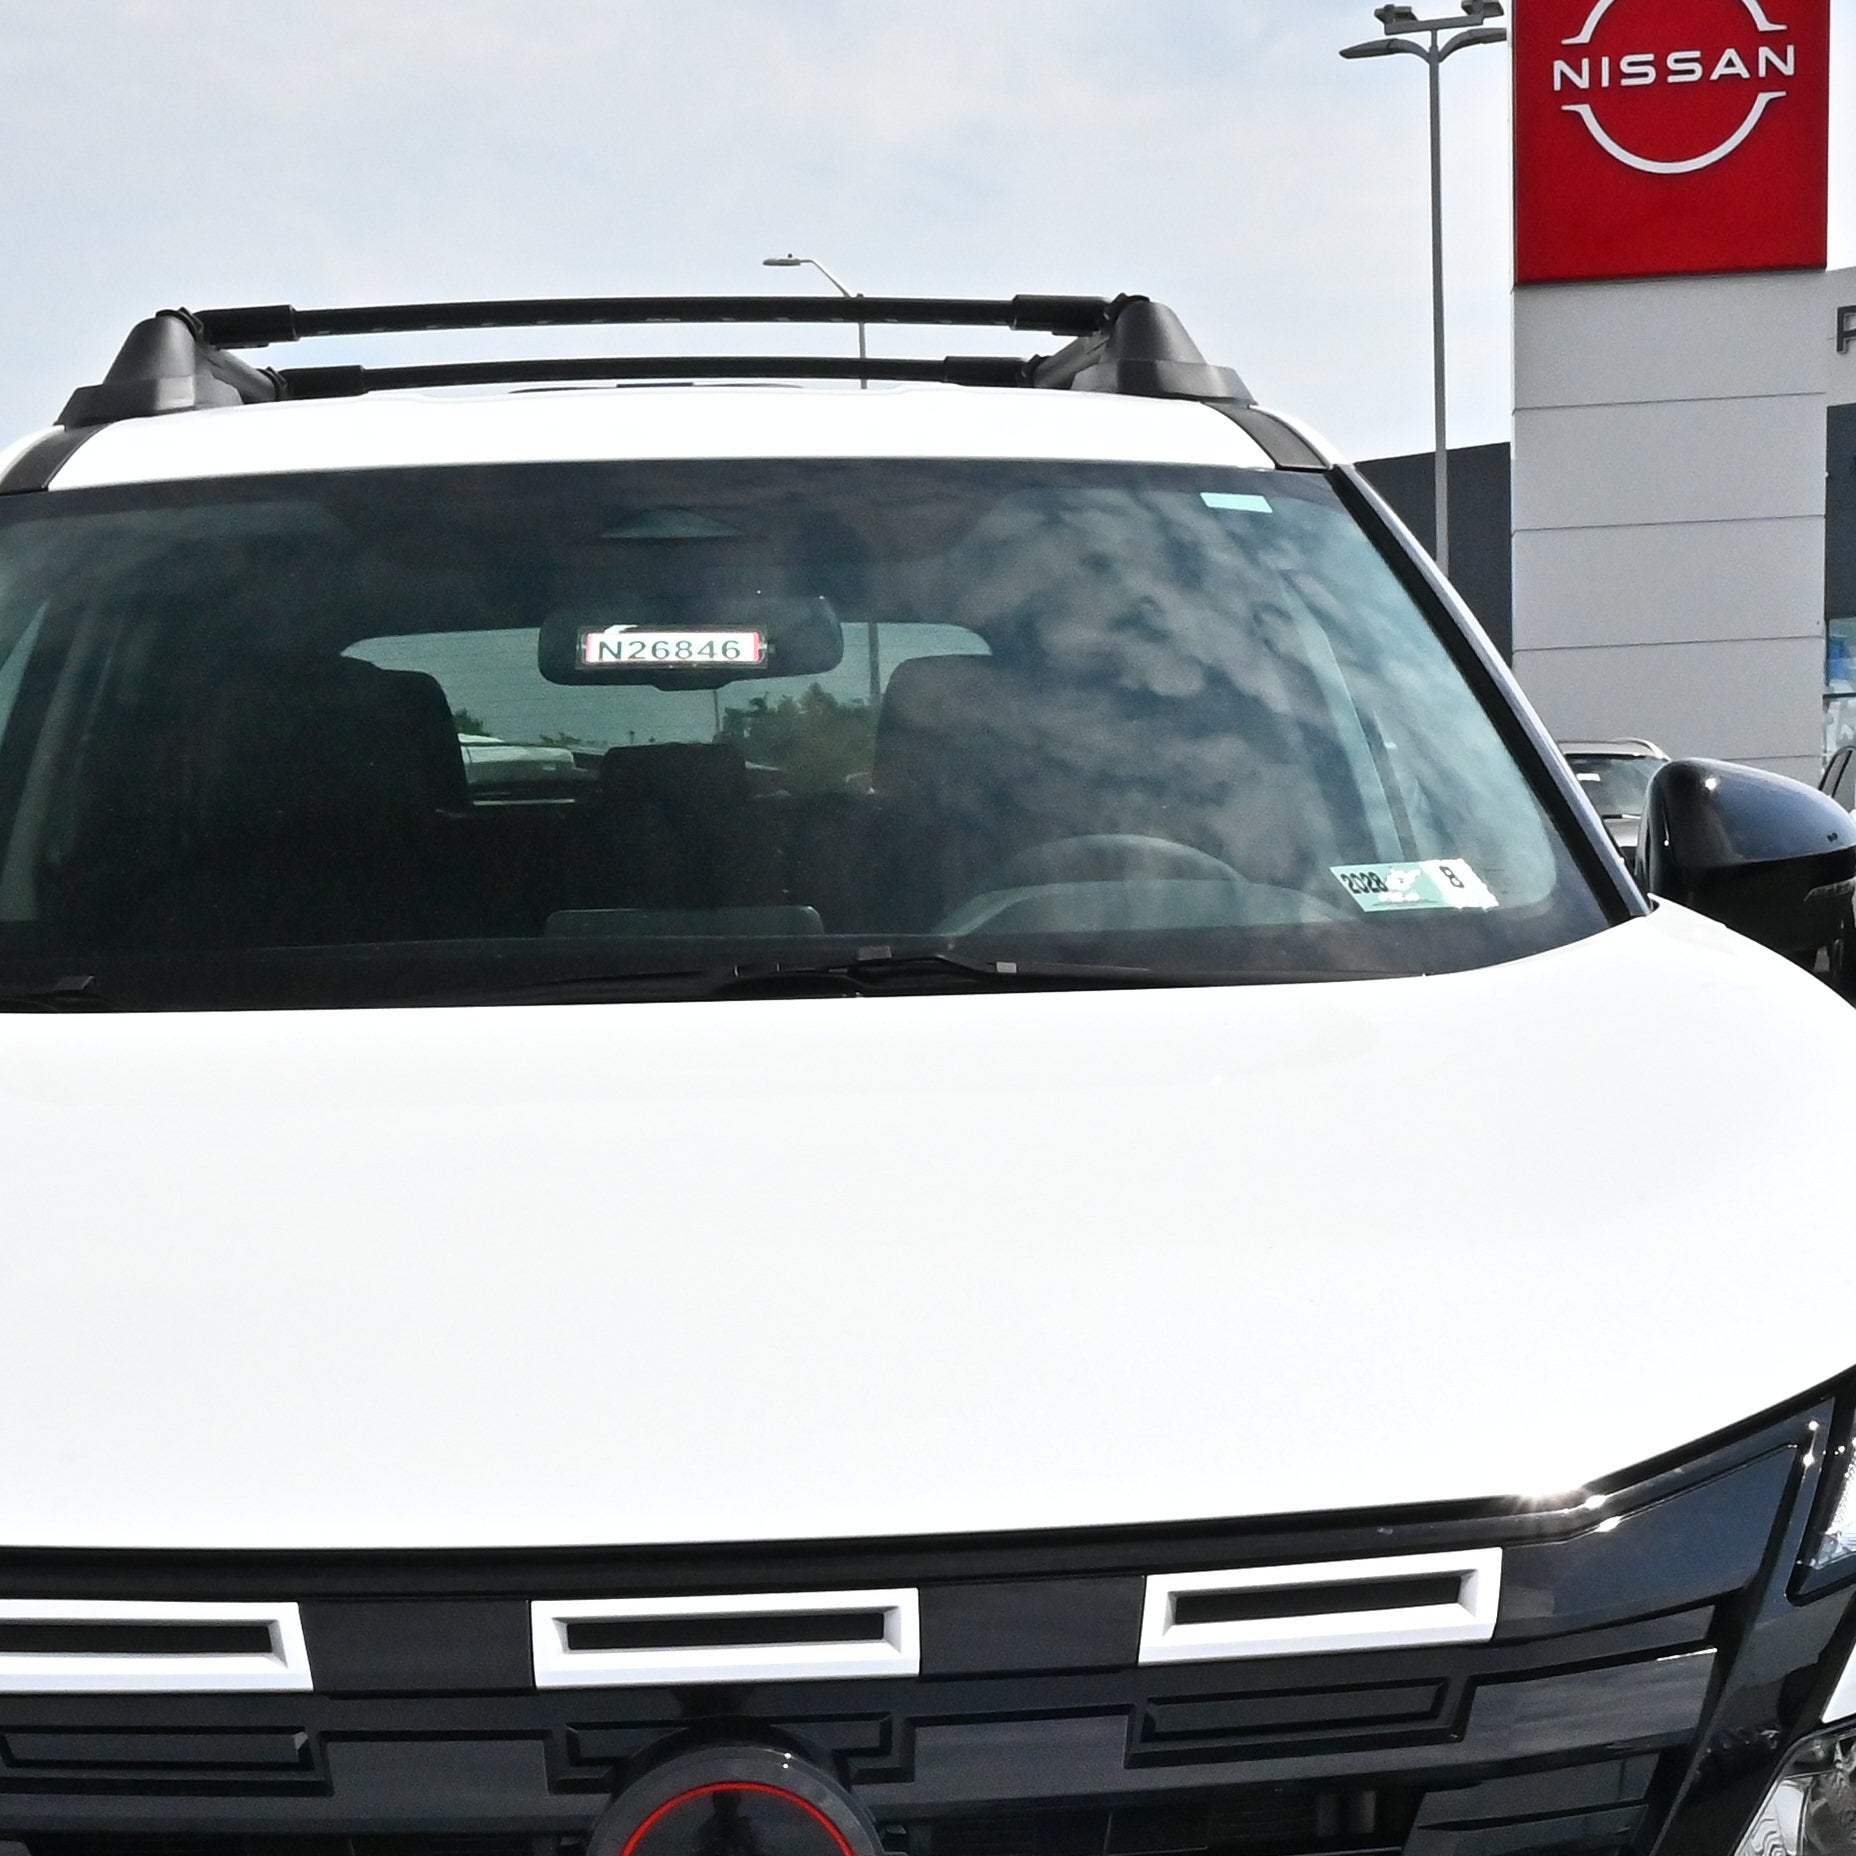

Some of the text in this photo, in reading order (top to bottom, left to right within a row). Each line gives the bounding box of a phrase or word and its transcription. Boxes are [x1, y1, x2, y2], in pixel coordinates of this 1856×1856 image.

[1553, 44, 1795, 91] NISSAN
[598, 640, 741, 660] N26846
[1340, 865, 1464, 894] 2028 8
